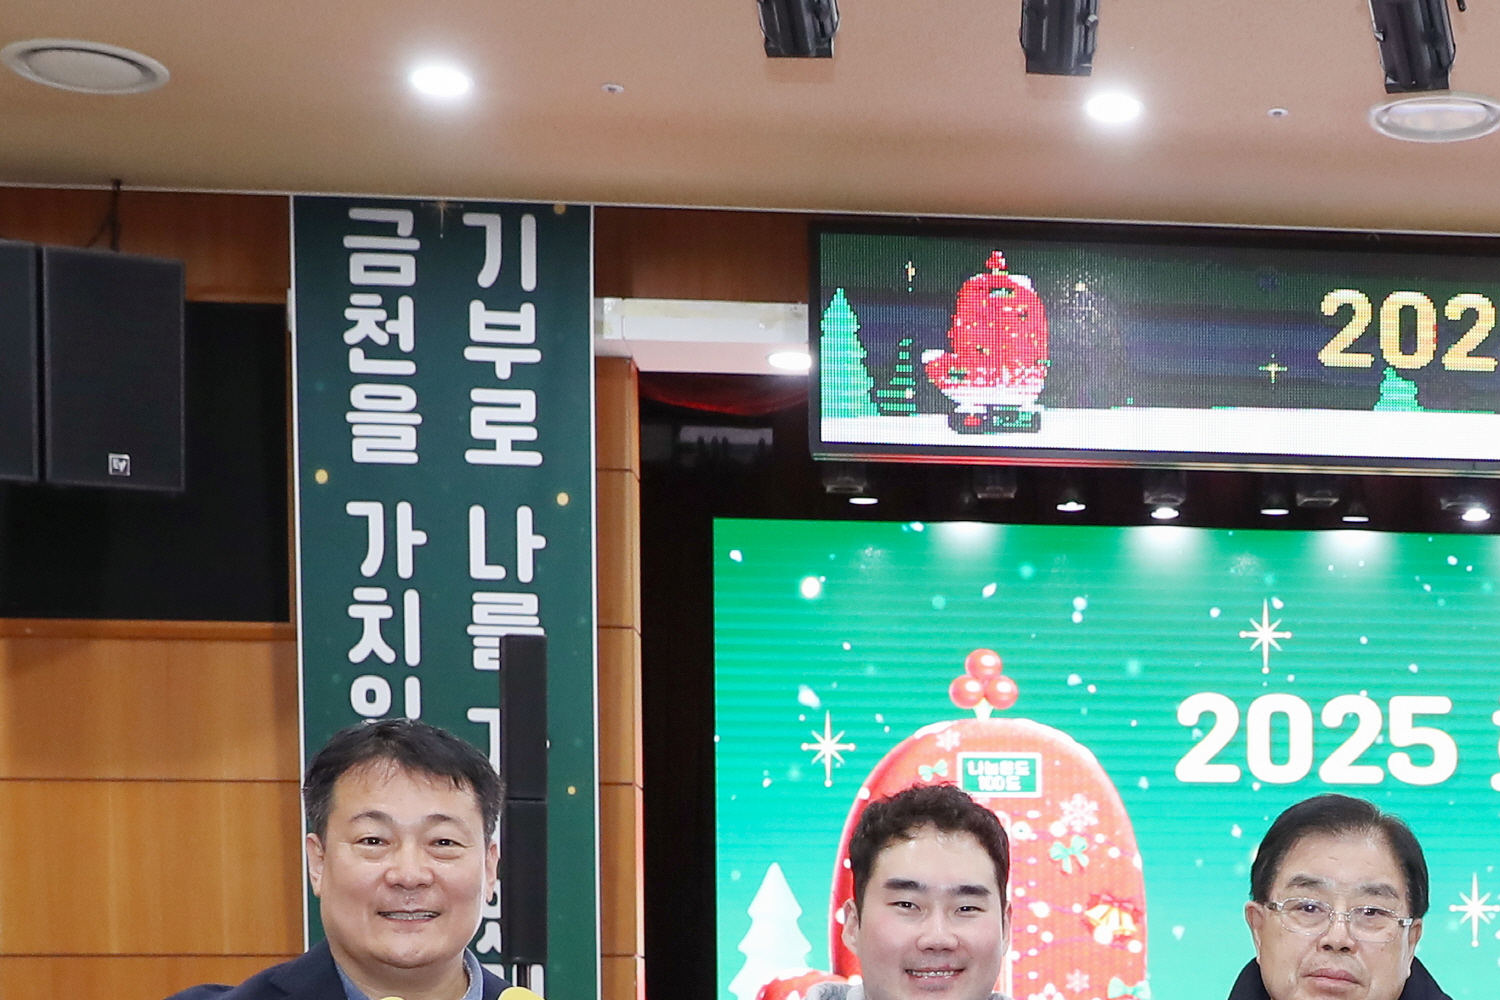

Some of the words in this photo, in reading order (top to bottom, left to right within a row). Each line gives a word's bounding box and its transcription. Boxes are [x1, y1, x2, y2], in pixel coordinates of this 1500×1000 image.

[342, 207, 423, 465] 금천을
[462, 212, 544, 466] 기부로
[1173, 692, 1459, 786] 2025
